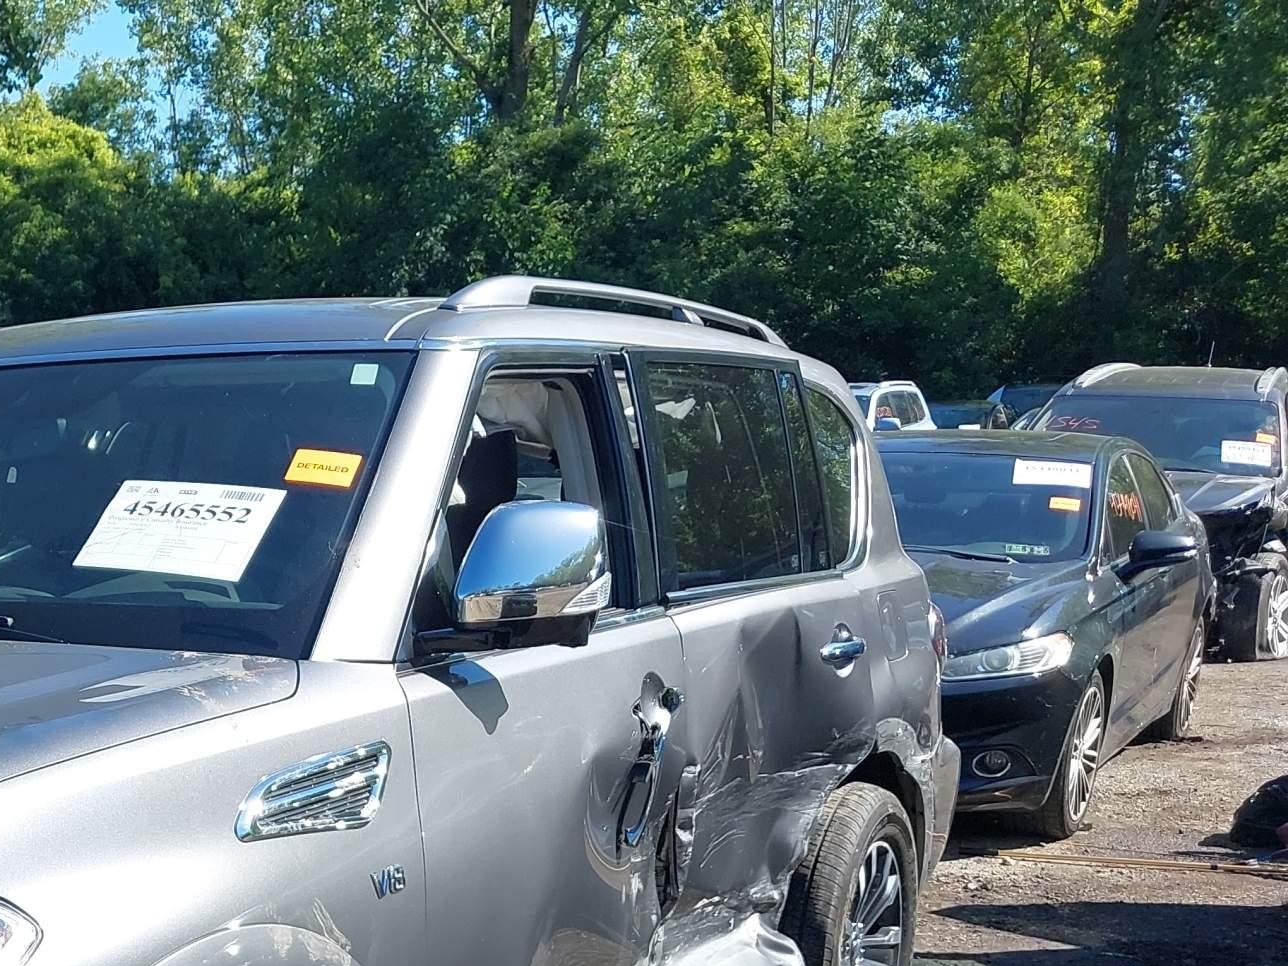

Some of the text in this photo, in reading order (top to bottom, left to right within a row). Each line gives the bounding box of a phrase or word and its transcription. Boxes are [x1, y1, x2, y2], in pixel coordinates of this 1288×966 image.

[296, 462, 349, 473] DETAILED
[123, 500, 252, 524] 45465552
[370, 864, 406, 900] V8
